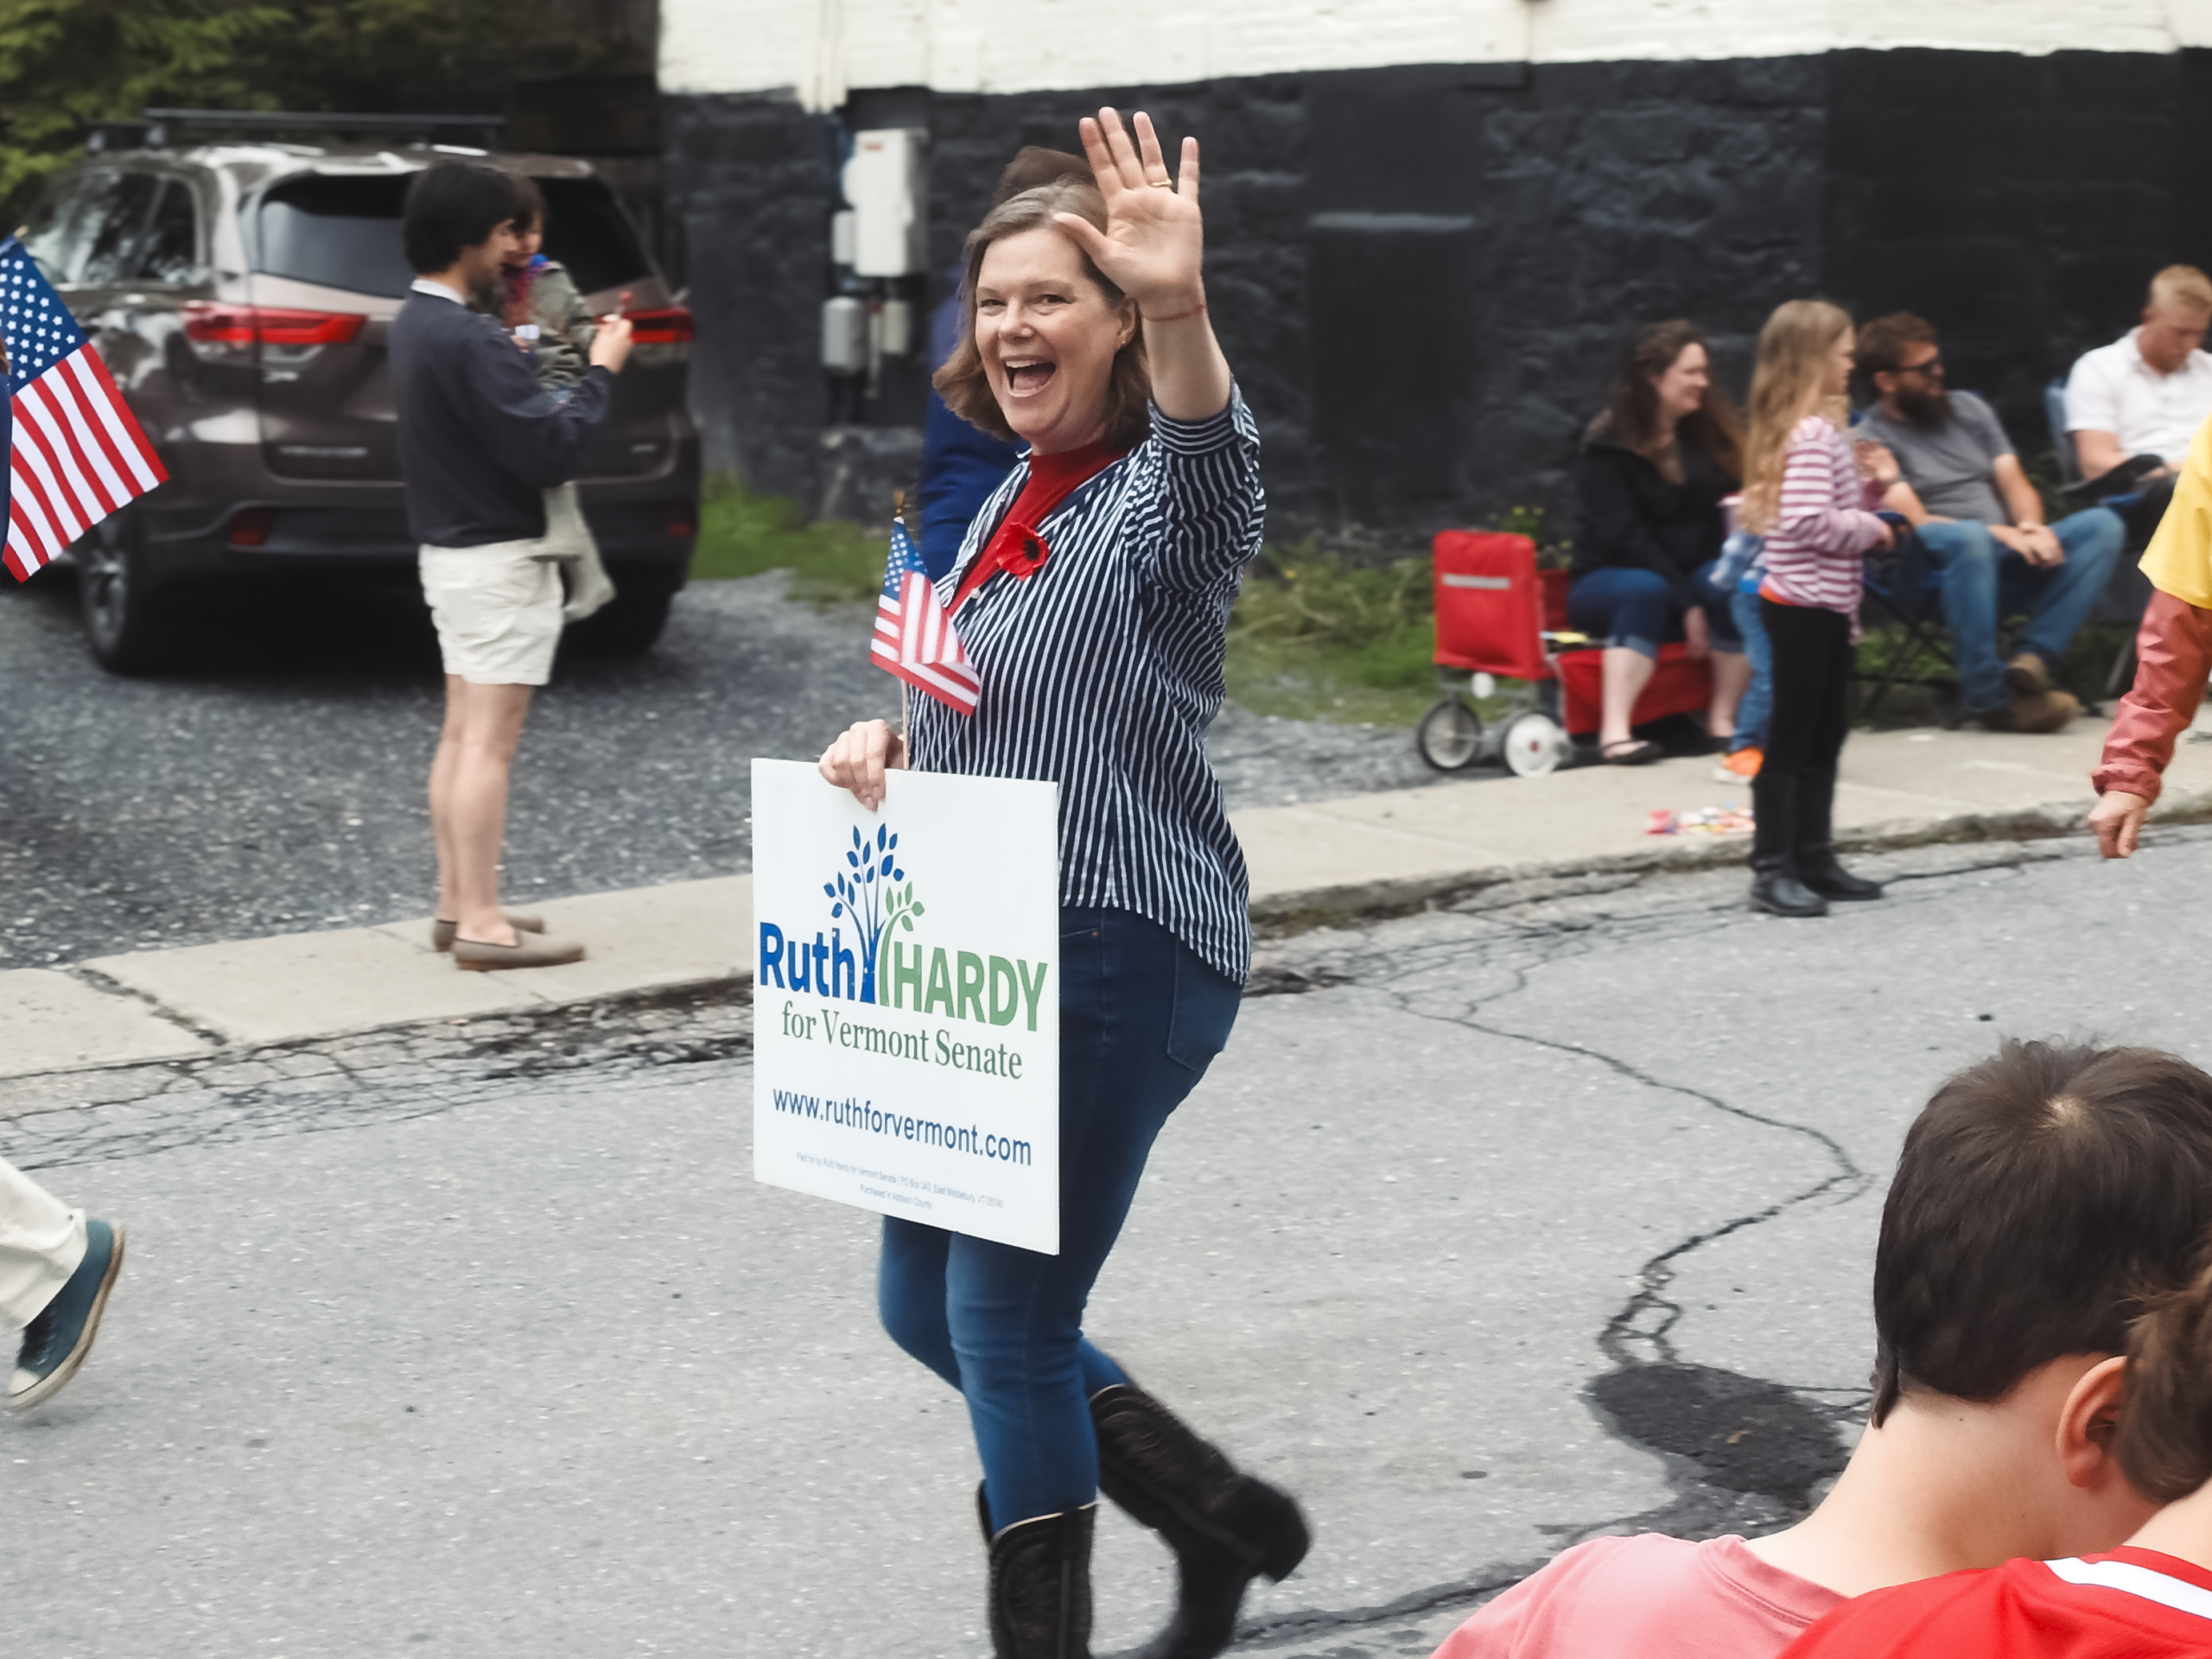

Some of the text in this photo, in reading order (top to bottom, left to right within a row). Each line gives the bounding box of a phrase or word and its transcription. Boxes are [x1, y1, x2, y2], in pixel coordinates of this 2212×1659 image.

[760, 921, 1048, 1032] Ruth HARDY
[781, 1000, 1022, 1080] for Vermont Senate
[772, 1087, 1033, 1166] www.ruthforvermont.com
